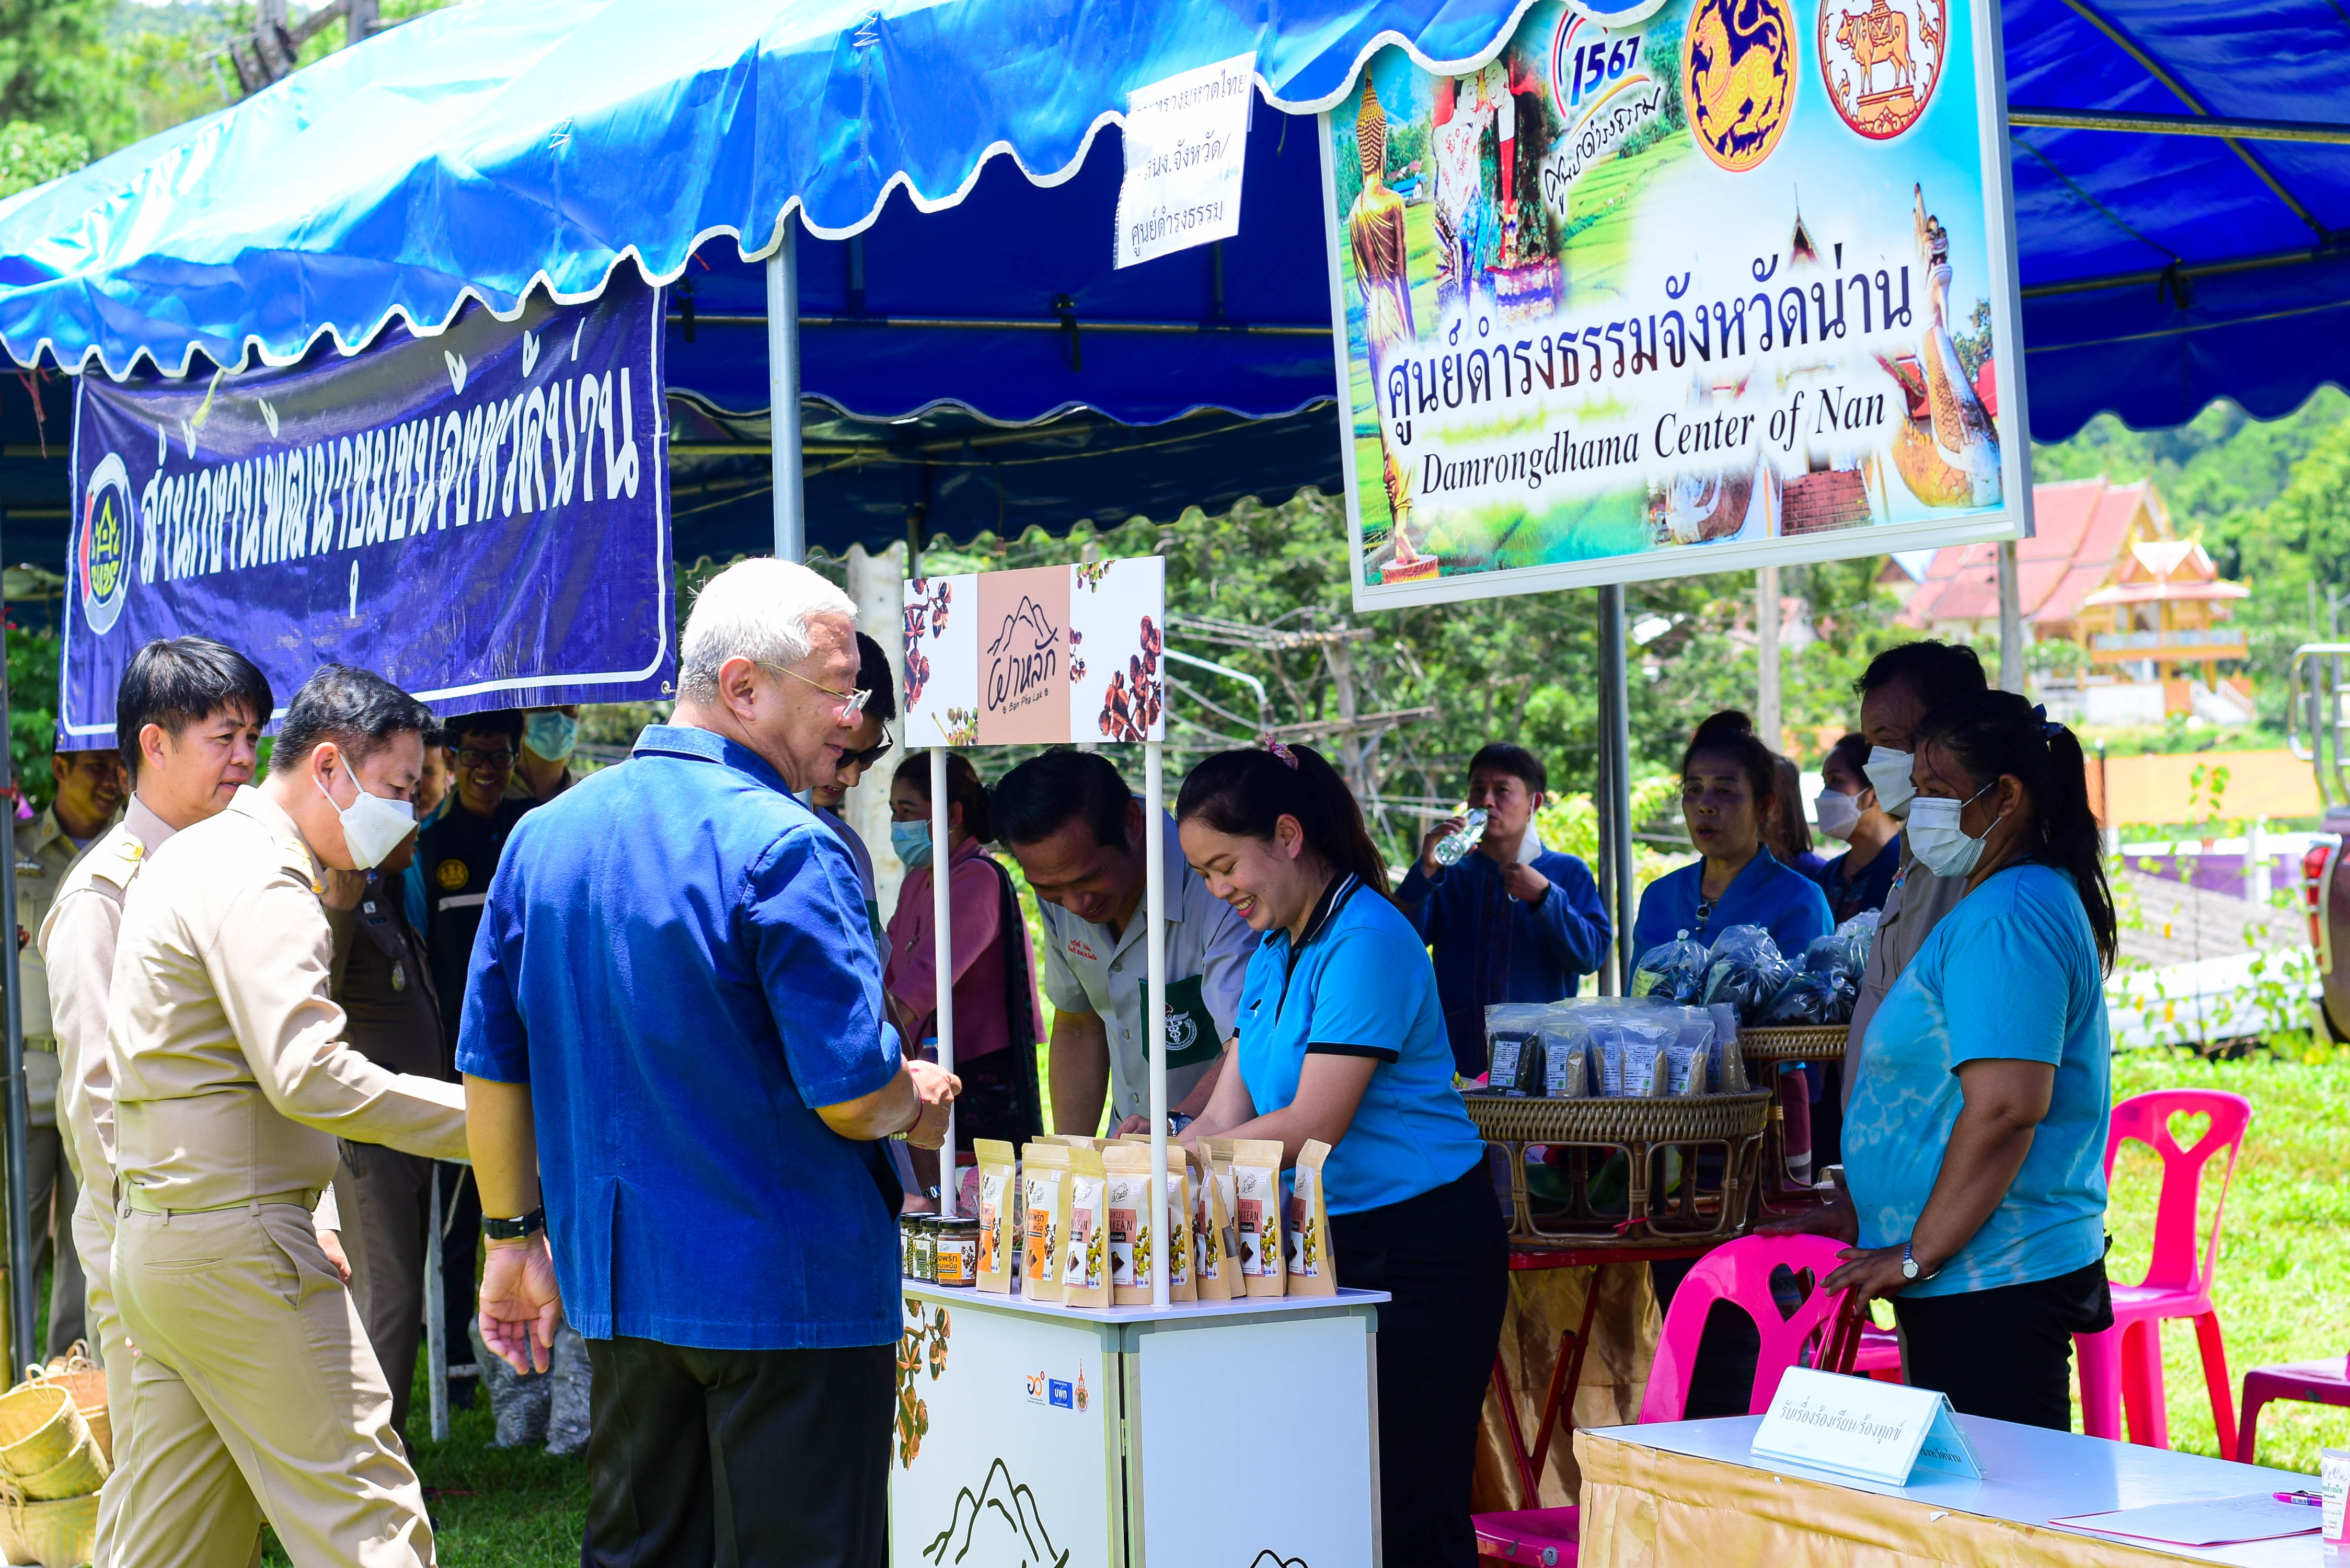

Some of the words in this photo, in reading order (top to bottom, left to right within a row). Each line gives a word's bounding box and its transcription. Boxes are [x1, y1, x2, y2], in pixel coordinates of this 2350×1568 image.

[1570, 35, 1641, 107] 1567
[1131, 201, 1224, 257] ศูนย์ดำรงธรรม
[1388, 243, 1912, 446] ศูนย์ดำรงธรรมจังหวัดน่าน
[140, 317, 640, 619] สำนักงานพัฒนาชุมชนจังหวัดน่าน
[1421, 429, 1640, 494] Damrongdhama
[1655, 410, 1755, 458] Center
[1769, 390, 1805, 452] of
[1815, 386, 1886, 434] Nan
[1009, 701, 1019, 712] Ban
[1021, 694, 1031, 707] Pha
[1033, 690, 1043, 702] Lak
[1110, 1210, 1124, 1219] DRIED
[1780, 1396, 1907, 1445] รับเรื่องร้องเรียน/ร้องทุกข์
